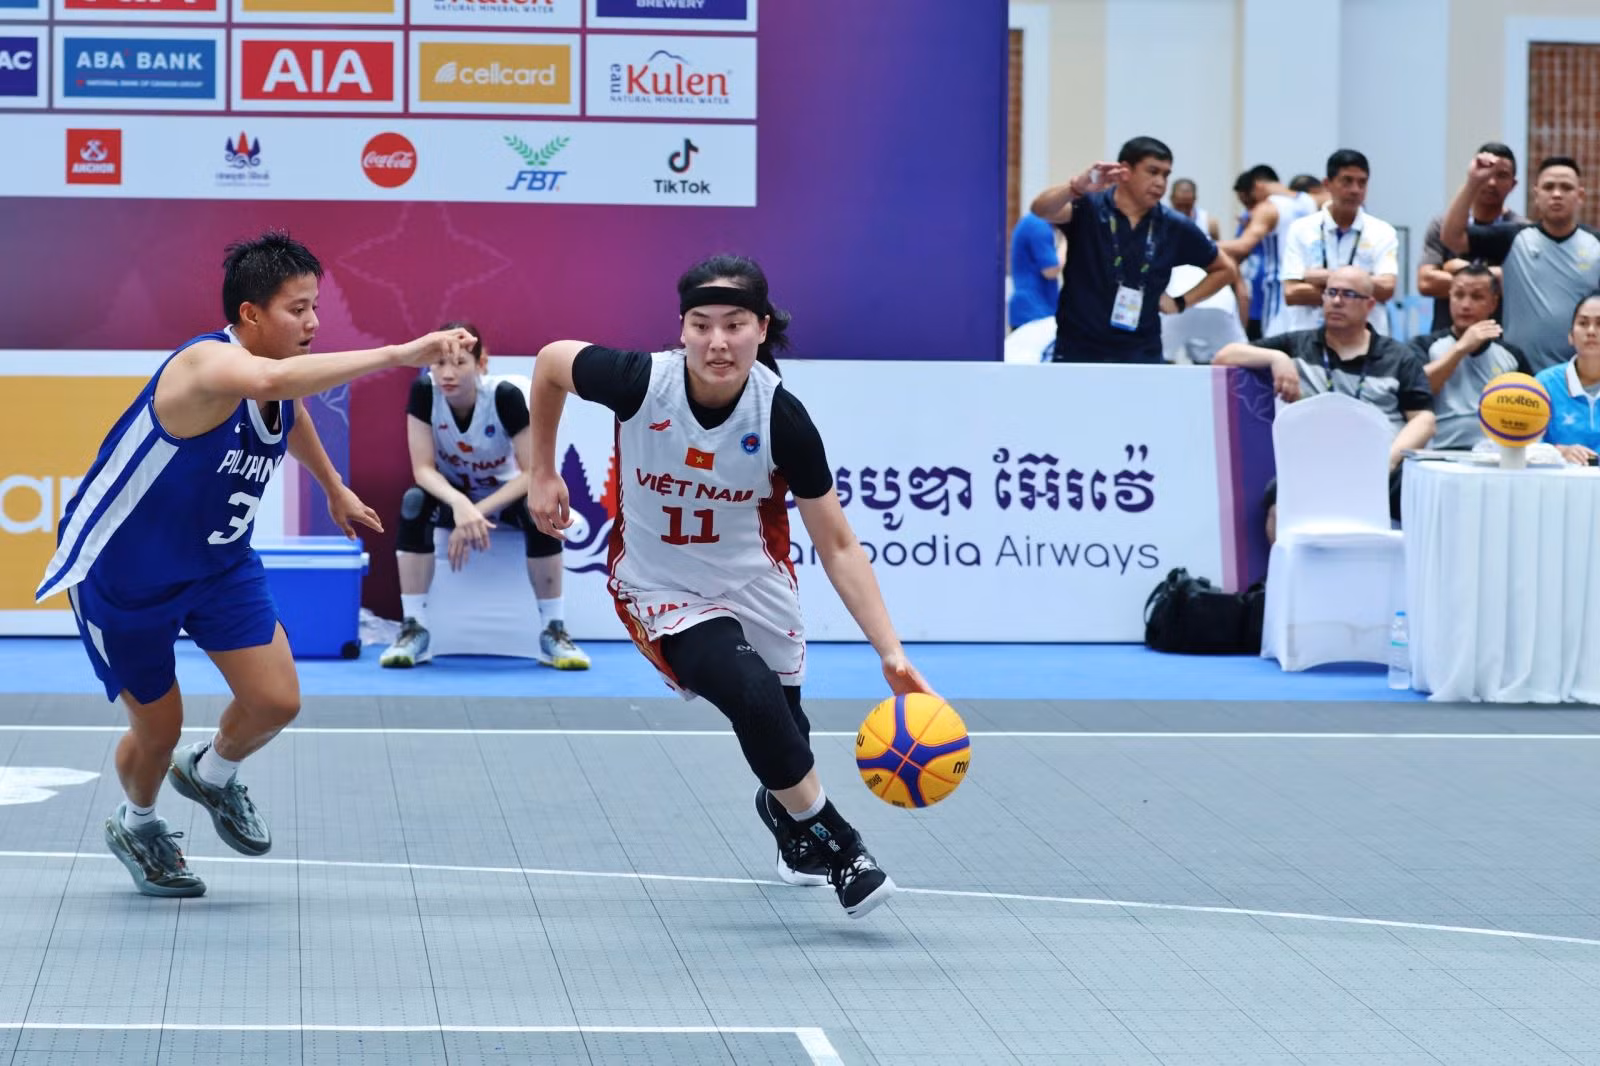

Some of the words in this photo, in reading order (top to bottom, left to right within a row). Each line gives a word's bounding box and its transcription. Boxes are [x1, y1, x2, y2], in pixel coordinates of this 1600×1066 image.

[76, 51, 125, 69] ABA
[136, 52, 203, 70] BANK
[262, 48, 373, 93] AIA
[459, 63, 556, 86] cellcard
[626, 63, 729, 96] Kulen
[506, 170, 567, 191] FBT
[654, 179, 711, 194] TikTok
[1497, 395, 1540, 409] molten
[636, 468, 692, 496] VIỆT
[695, 483, 753, 502] NAM
[207, 491, 260, 544] 3
[661, 506, 720, 545] 11
[995, 535, 1160, 575] Airways
